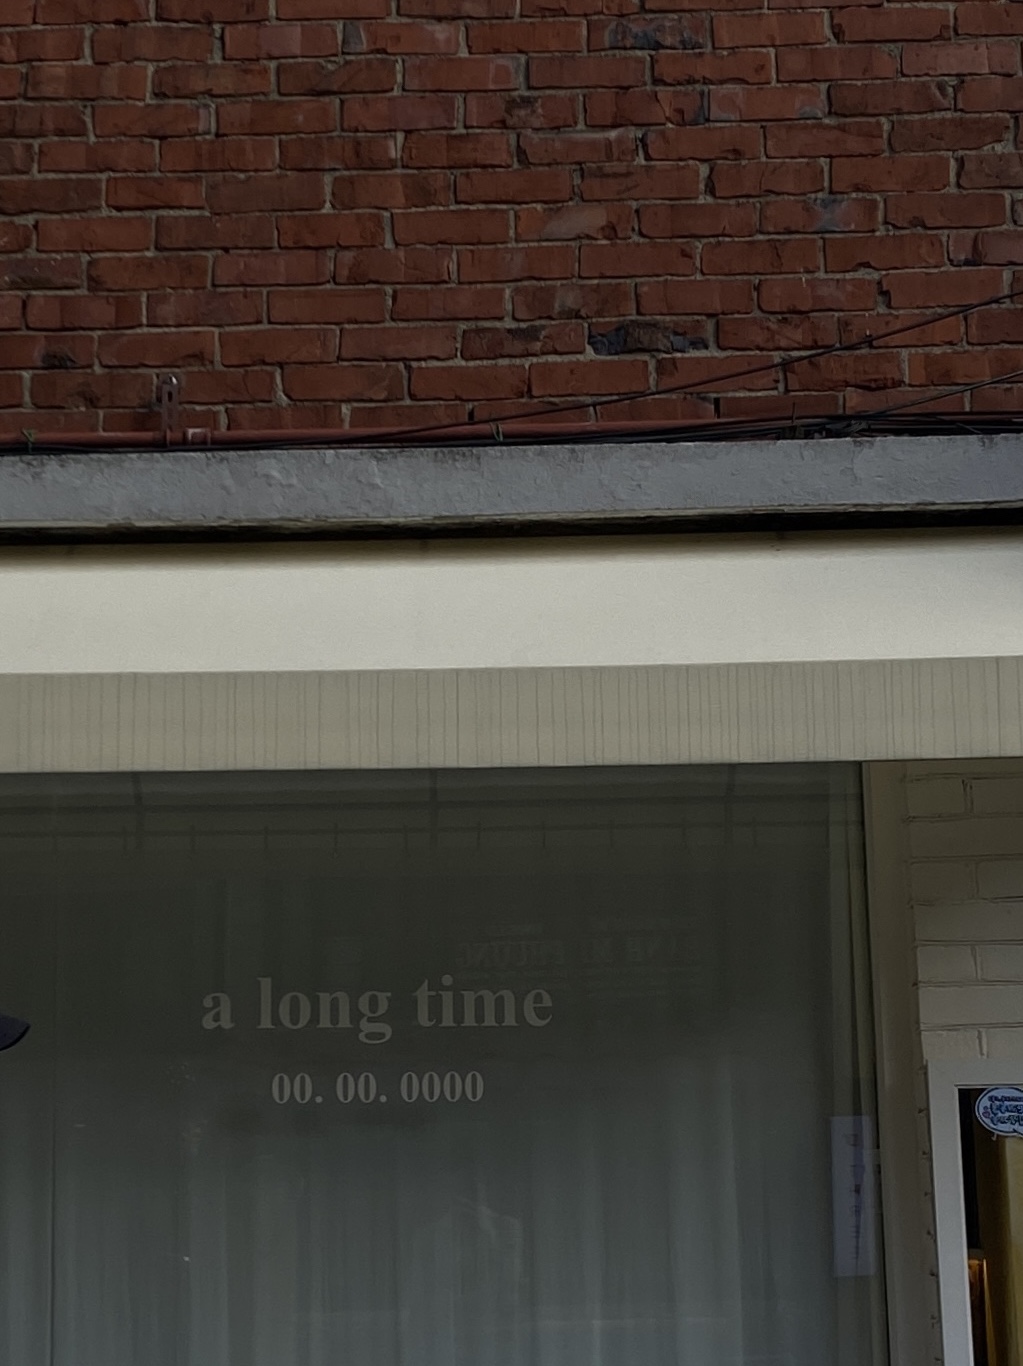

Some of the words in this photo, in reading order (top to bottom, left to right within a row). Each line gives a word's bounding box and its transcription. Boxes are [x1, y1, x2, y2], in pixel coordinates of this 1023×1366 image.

[202, 991, 234, 1030] a
[256, 976, 393, 1044] long
[413, 974, 553, 1028] time
[271, 1072, 323, 1104] 00.
[335, 1072, 387, 1103] 00.
[400, 1071, 485, 1102] 0000
